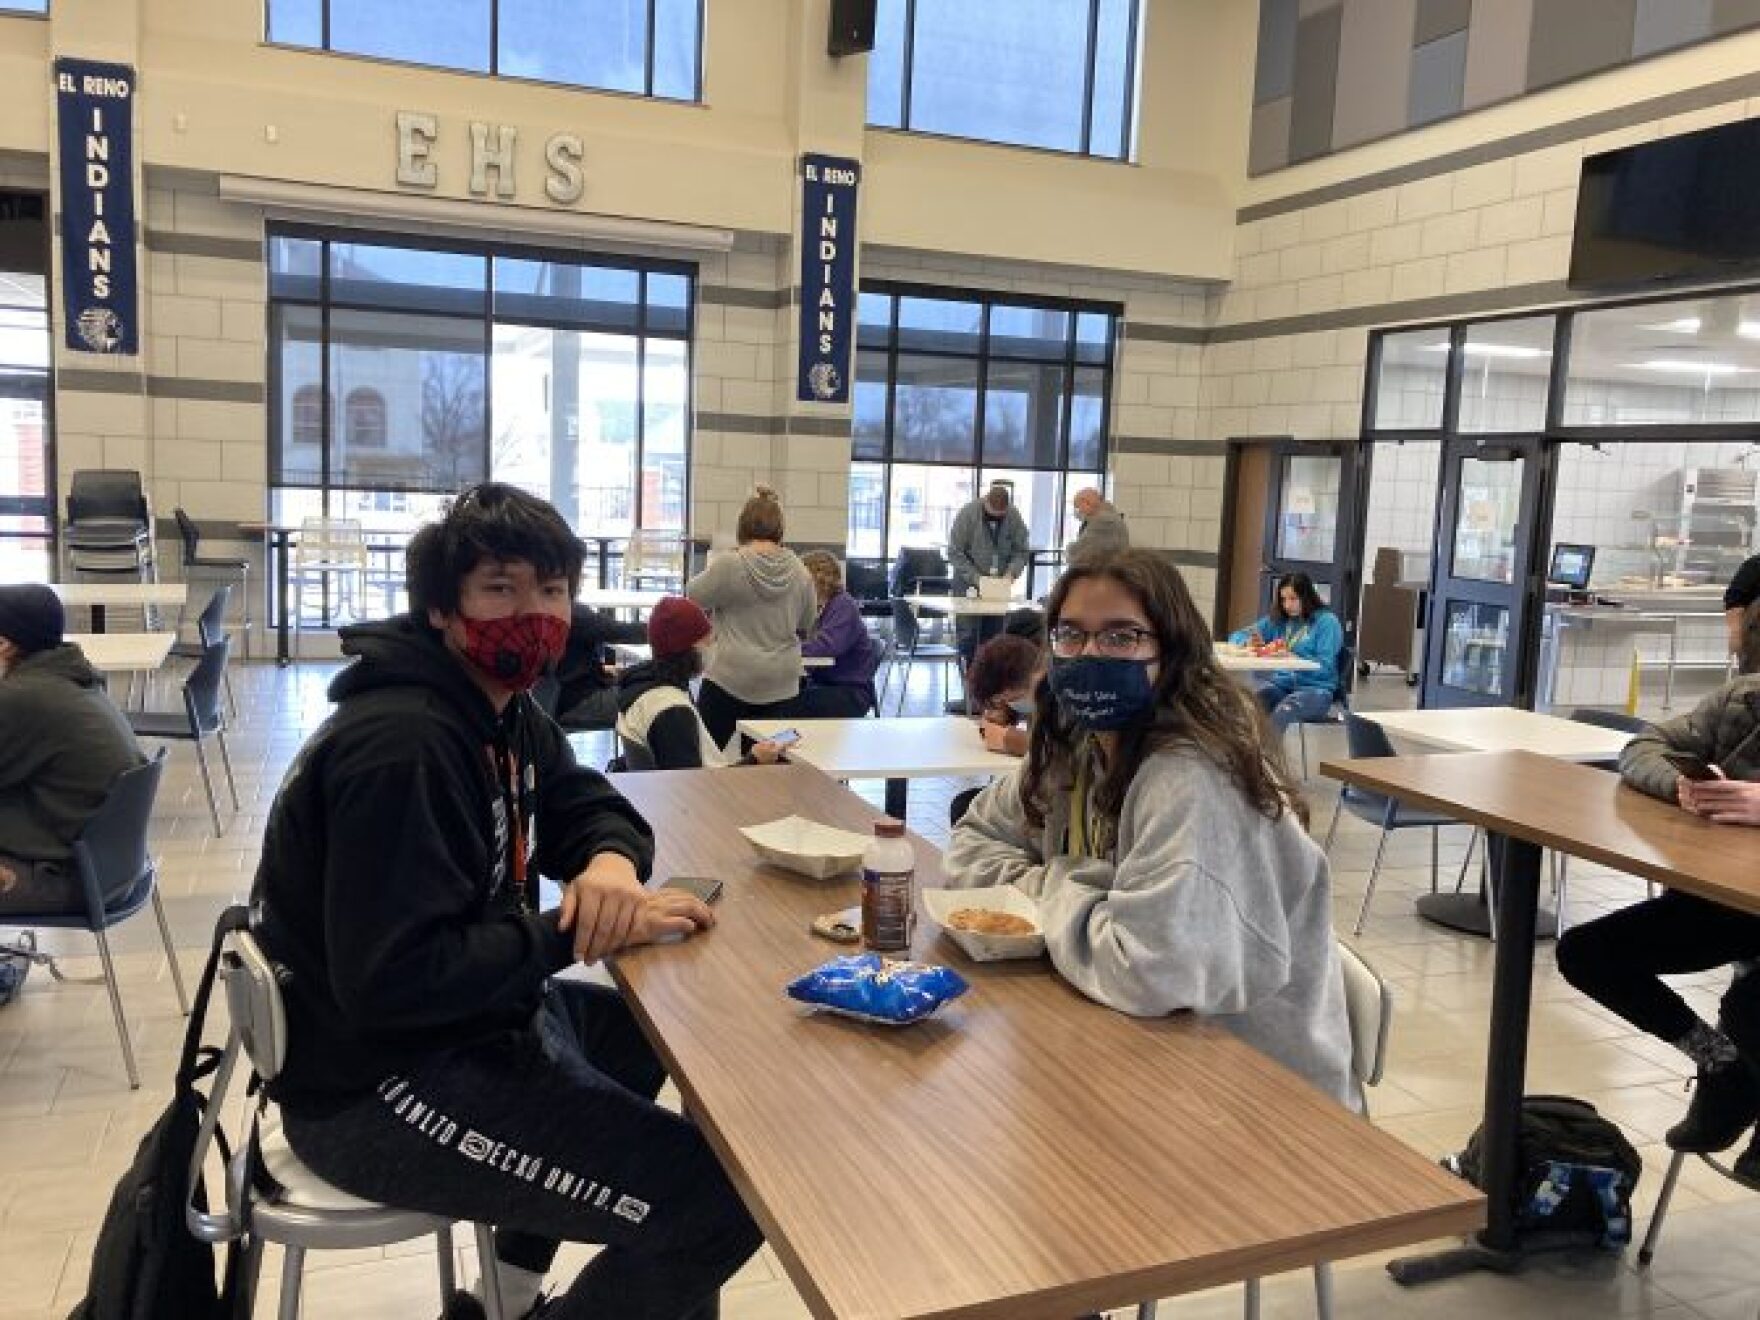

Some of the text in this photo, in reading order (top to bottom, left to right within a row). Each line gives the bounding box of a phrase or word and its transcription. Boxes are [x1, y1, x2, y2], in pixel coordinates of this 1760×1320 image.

[59, 73, 129, 98] EL RENO
[395, 111, 586, 203] EHS
[806, 164, 855, 187] EL RENO
[86, 108, 112, 299] INDIANS
[819, 194, 836, 353] INDIANS
